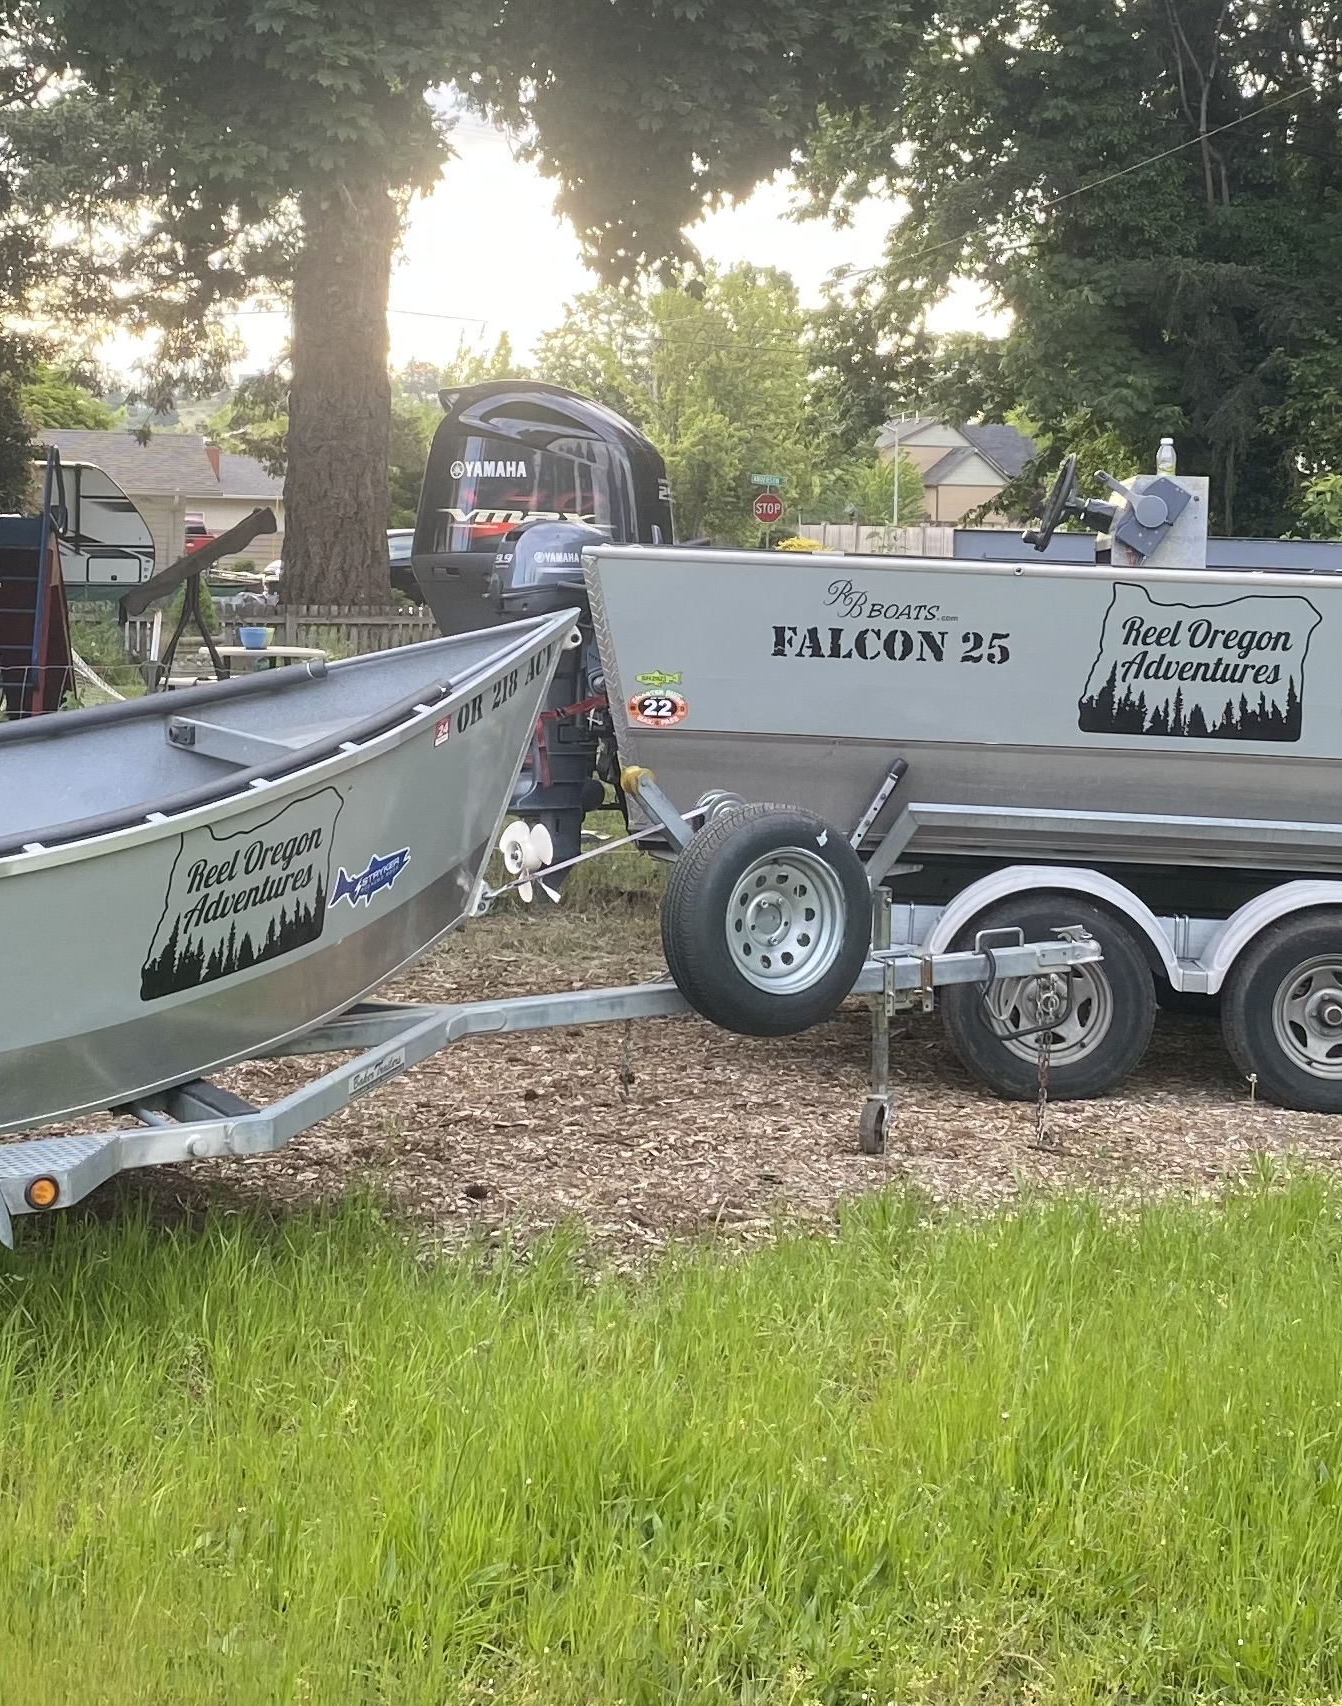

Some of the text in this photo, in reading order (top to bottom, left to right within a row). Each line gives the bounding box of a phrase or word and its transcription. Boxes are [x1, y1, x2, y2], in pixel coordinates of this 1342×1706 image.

[465, 460, 527, 478] YAMAHA
[755, 503, 781, 514] STOP
[545, 552, 580, 562] YAMAHA
[771, 626, 1010, 664] FALCON 25
[1121, 616, 1293, 659] Reel Oregon
[1121, 651, 1282, 684] Adventures
[457, 694, 483, 733] OR
[492, 669, 518, 711] 218
[643, 699, 672, 717] 22
[438, 721, 449, 736] 24
[187, 827, 323, 894] Reel Oregon
[361, 856, 400, 887] STRYKER
[183, 863, 315, 935] Adventures
